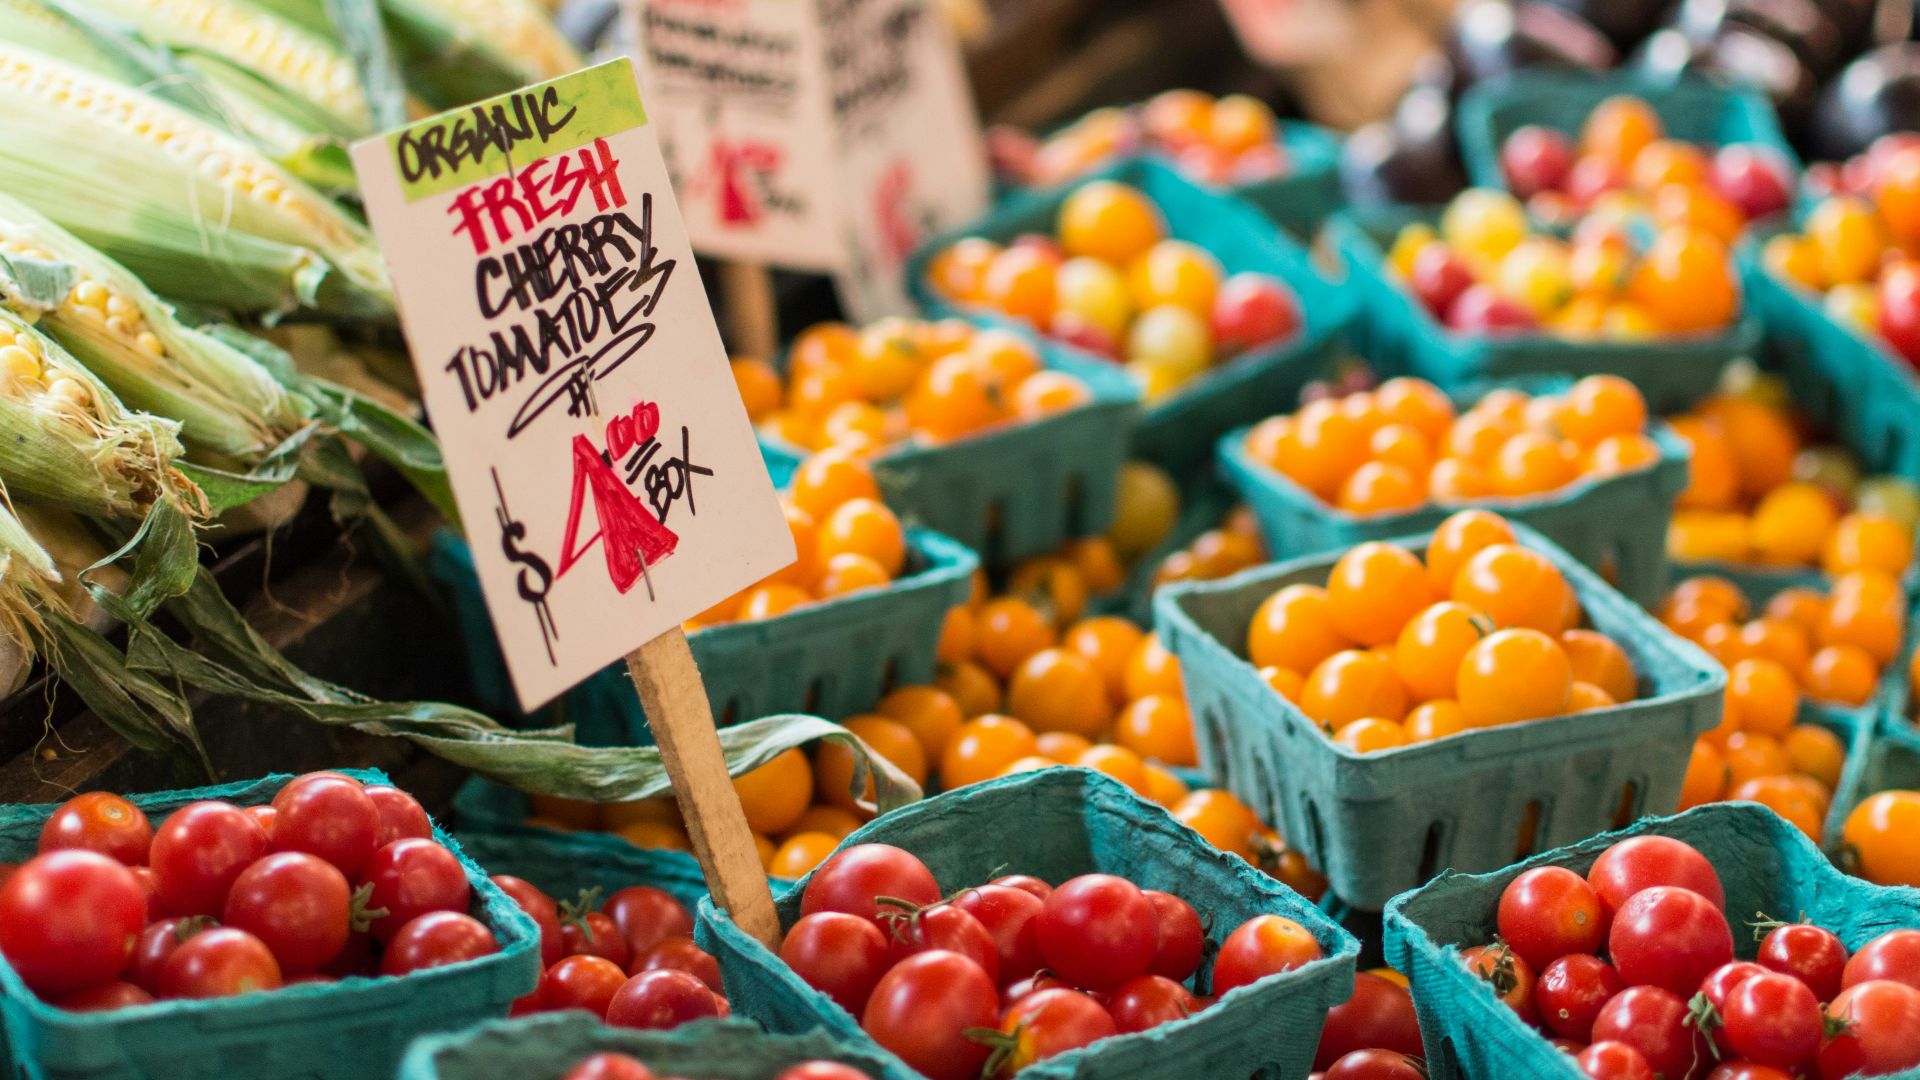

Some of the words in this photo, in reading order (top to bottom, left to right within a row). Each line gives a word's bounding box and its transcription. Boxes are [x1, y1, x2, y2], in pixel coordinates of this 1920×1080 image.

[397, 87, 577, 184] ORGANIC
[447, 137, 628, 255] FRESH
[476, 193, 653, 319] CHERRY
[445, 248, 677, 412] TOMATOES
[645, 426, 714, 524] BOX
